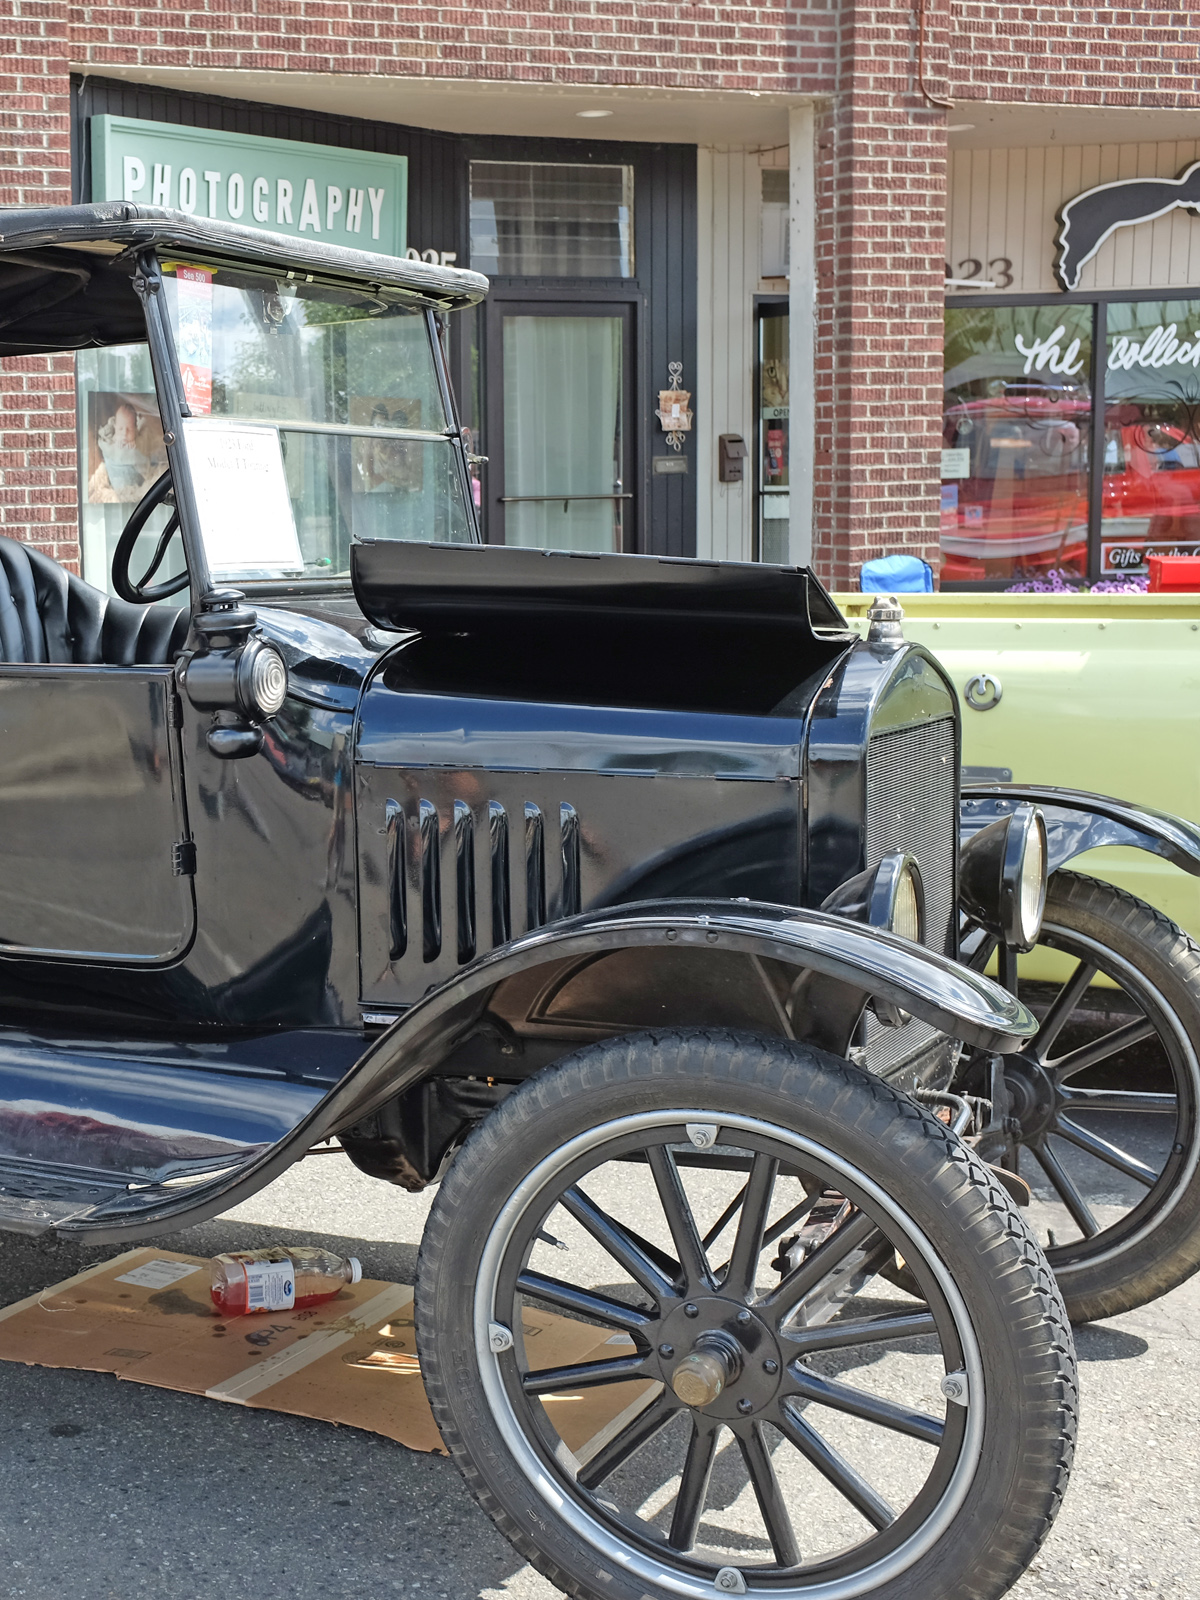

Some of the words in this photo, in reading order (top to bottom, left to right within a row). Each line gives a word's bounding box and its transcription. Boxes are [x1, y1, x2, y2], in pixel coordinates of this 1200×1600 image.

[123, 156, 385, 240] PHOTOGRAPHY
[945, 257, 1014, 290] 23
[1109, 548, 1141, 568] Gifts
